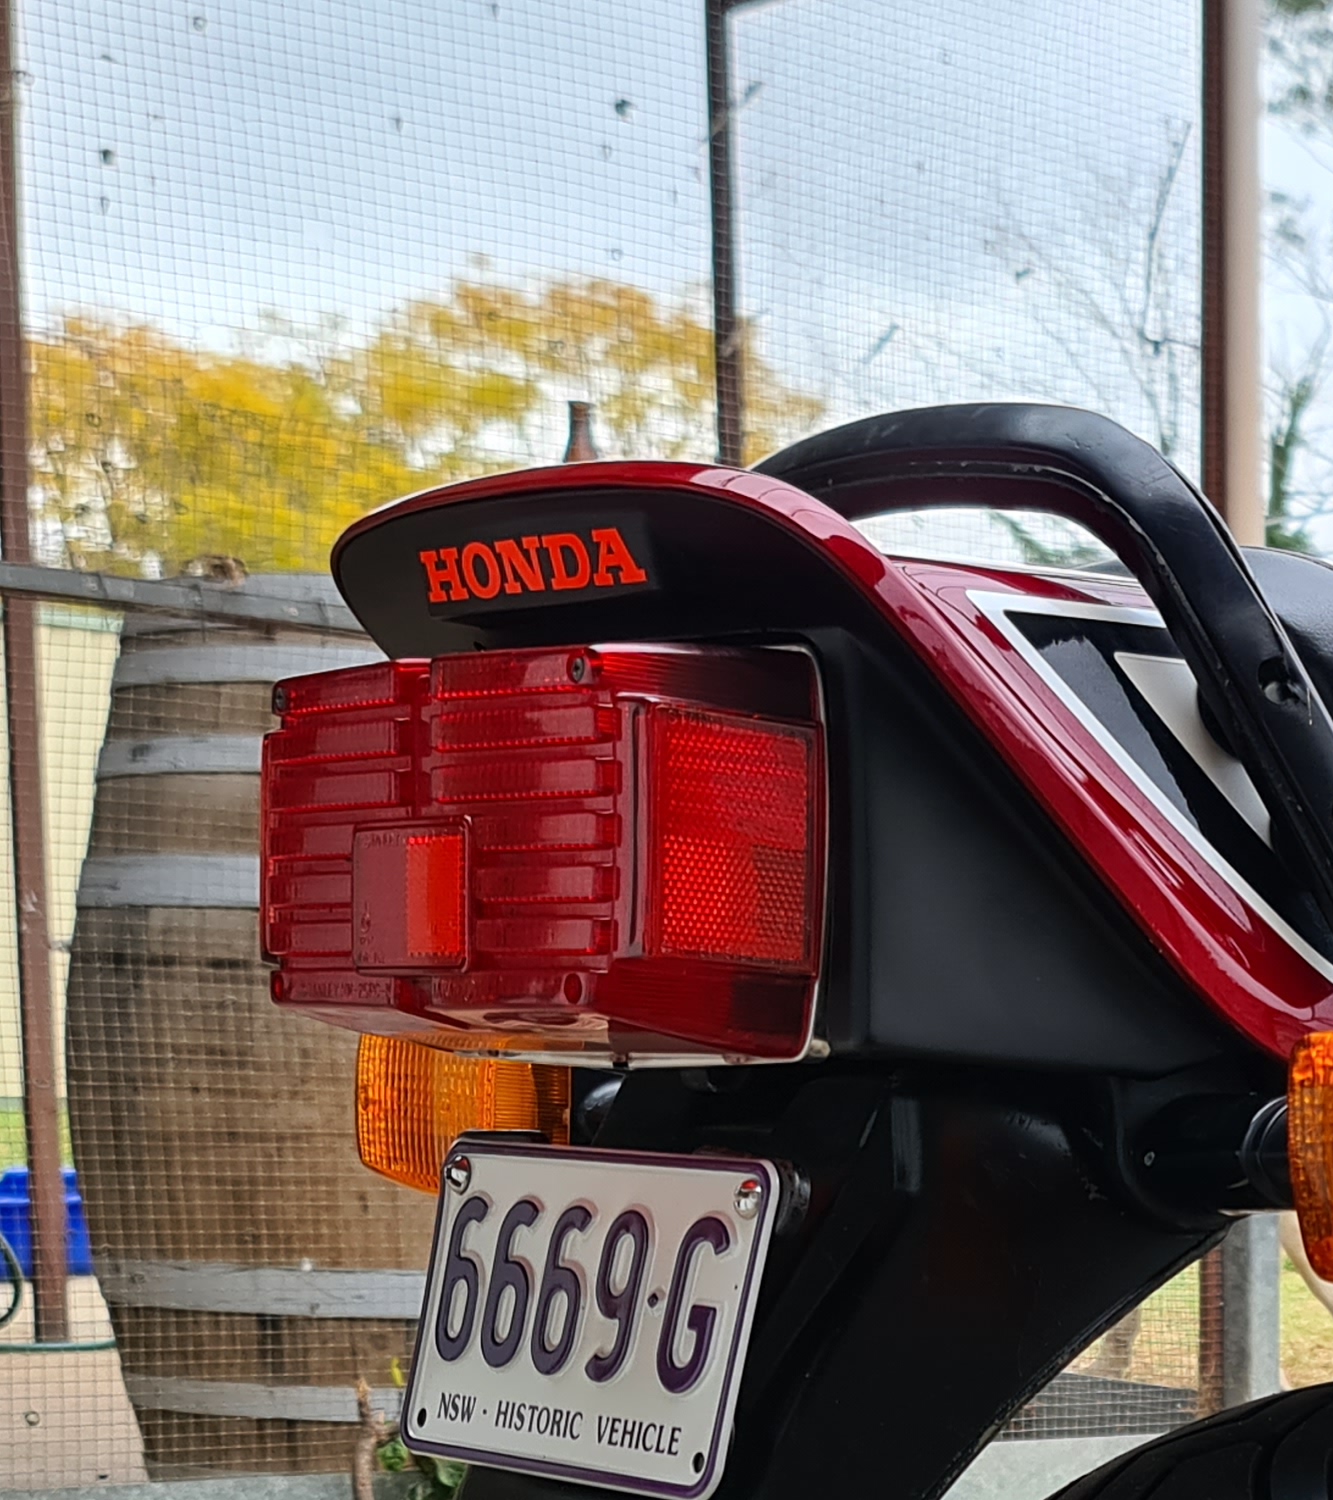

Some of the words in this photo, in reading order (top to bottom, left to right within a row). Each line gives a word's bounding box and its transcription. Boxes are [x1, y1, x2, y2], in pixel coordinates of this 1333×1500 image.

[420, 527, 648, 603] HONDA
[437, 1391, 478, 1422] NSW
[494, 1399, 584, 1441] HISTORIC
[597, 1414, 682, 1457] VEHICLE
